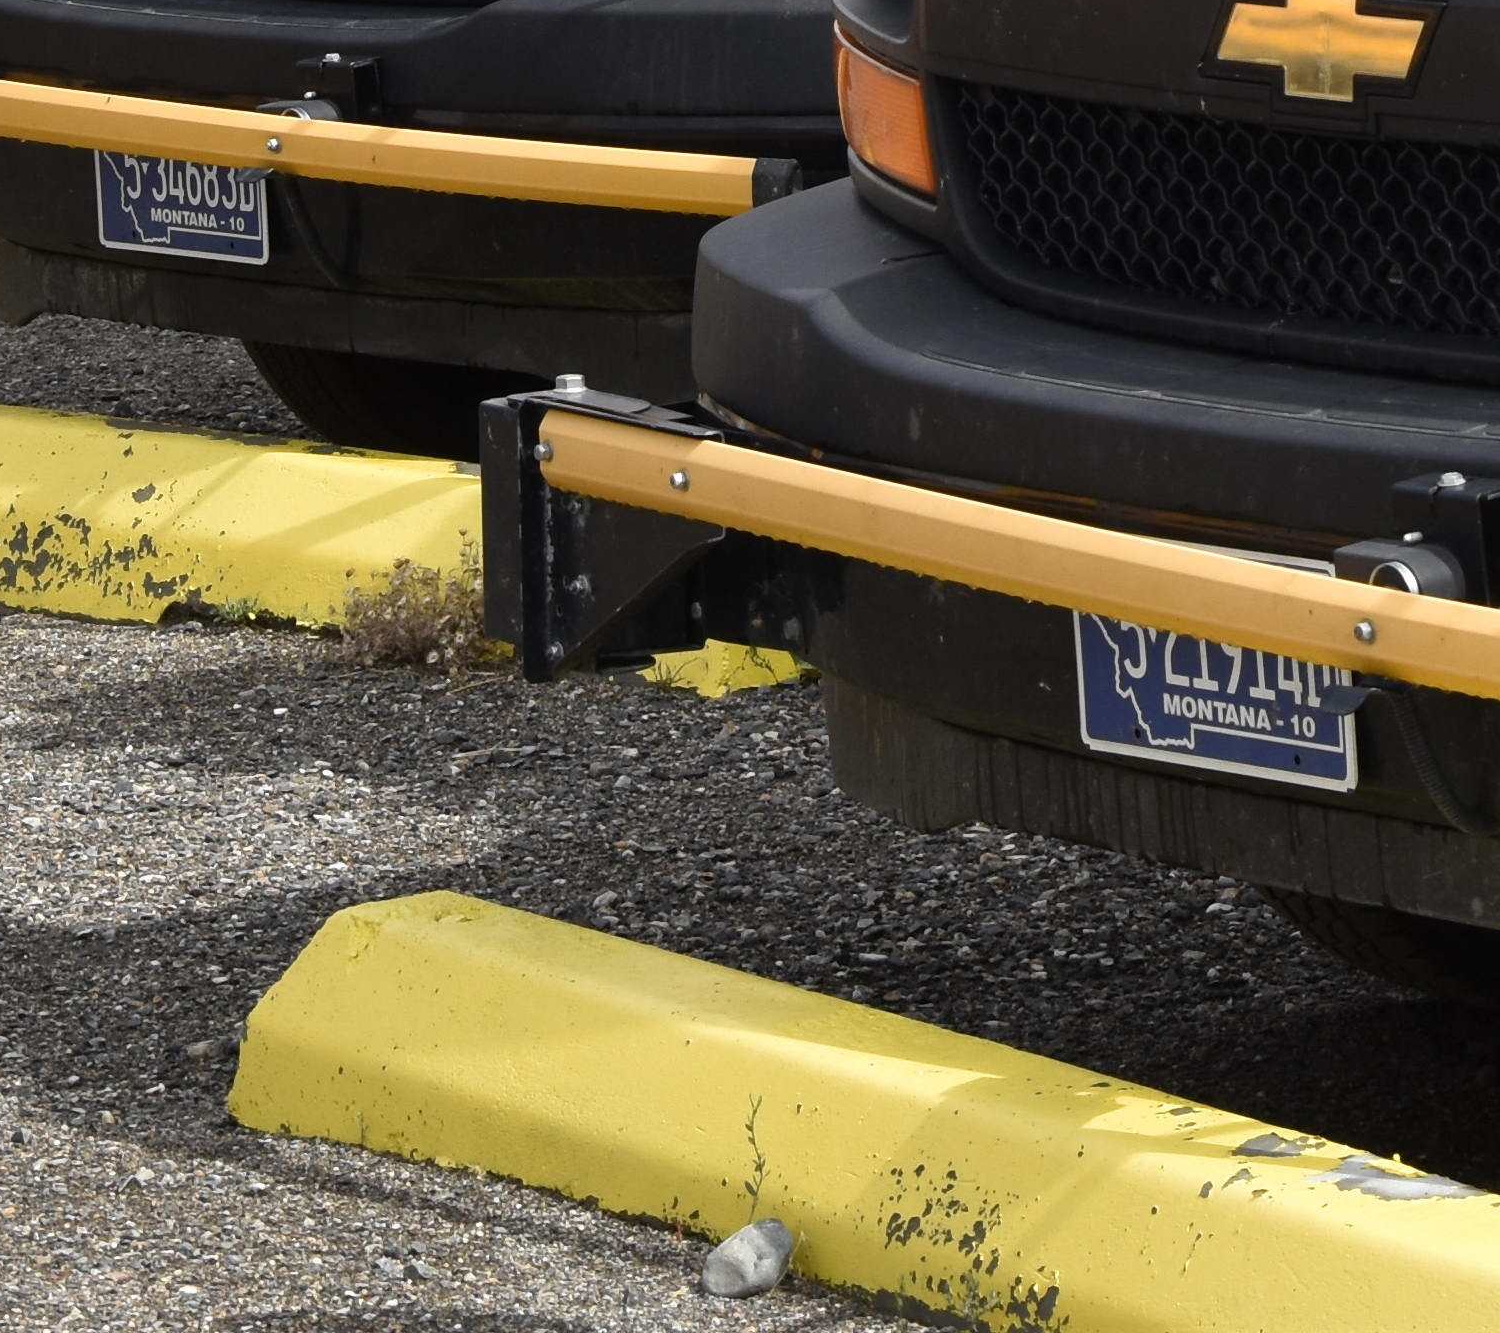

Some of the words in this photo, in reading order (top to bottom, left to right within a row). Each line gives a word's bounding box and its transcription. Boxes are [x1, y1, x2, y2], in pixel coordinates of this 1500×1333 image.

[150, 207, 218, 229] MONTANA
[229, 215, 245, 232] 10
[1162, 692, 1272, 732] MONTANA
[1290, 713, 1317, 739] 10
